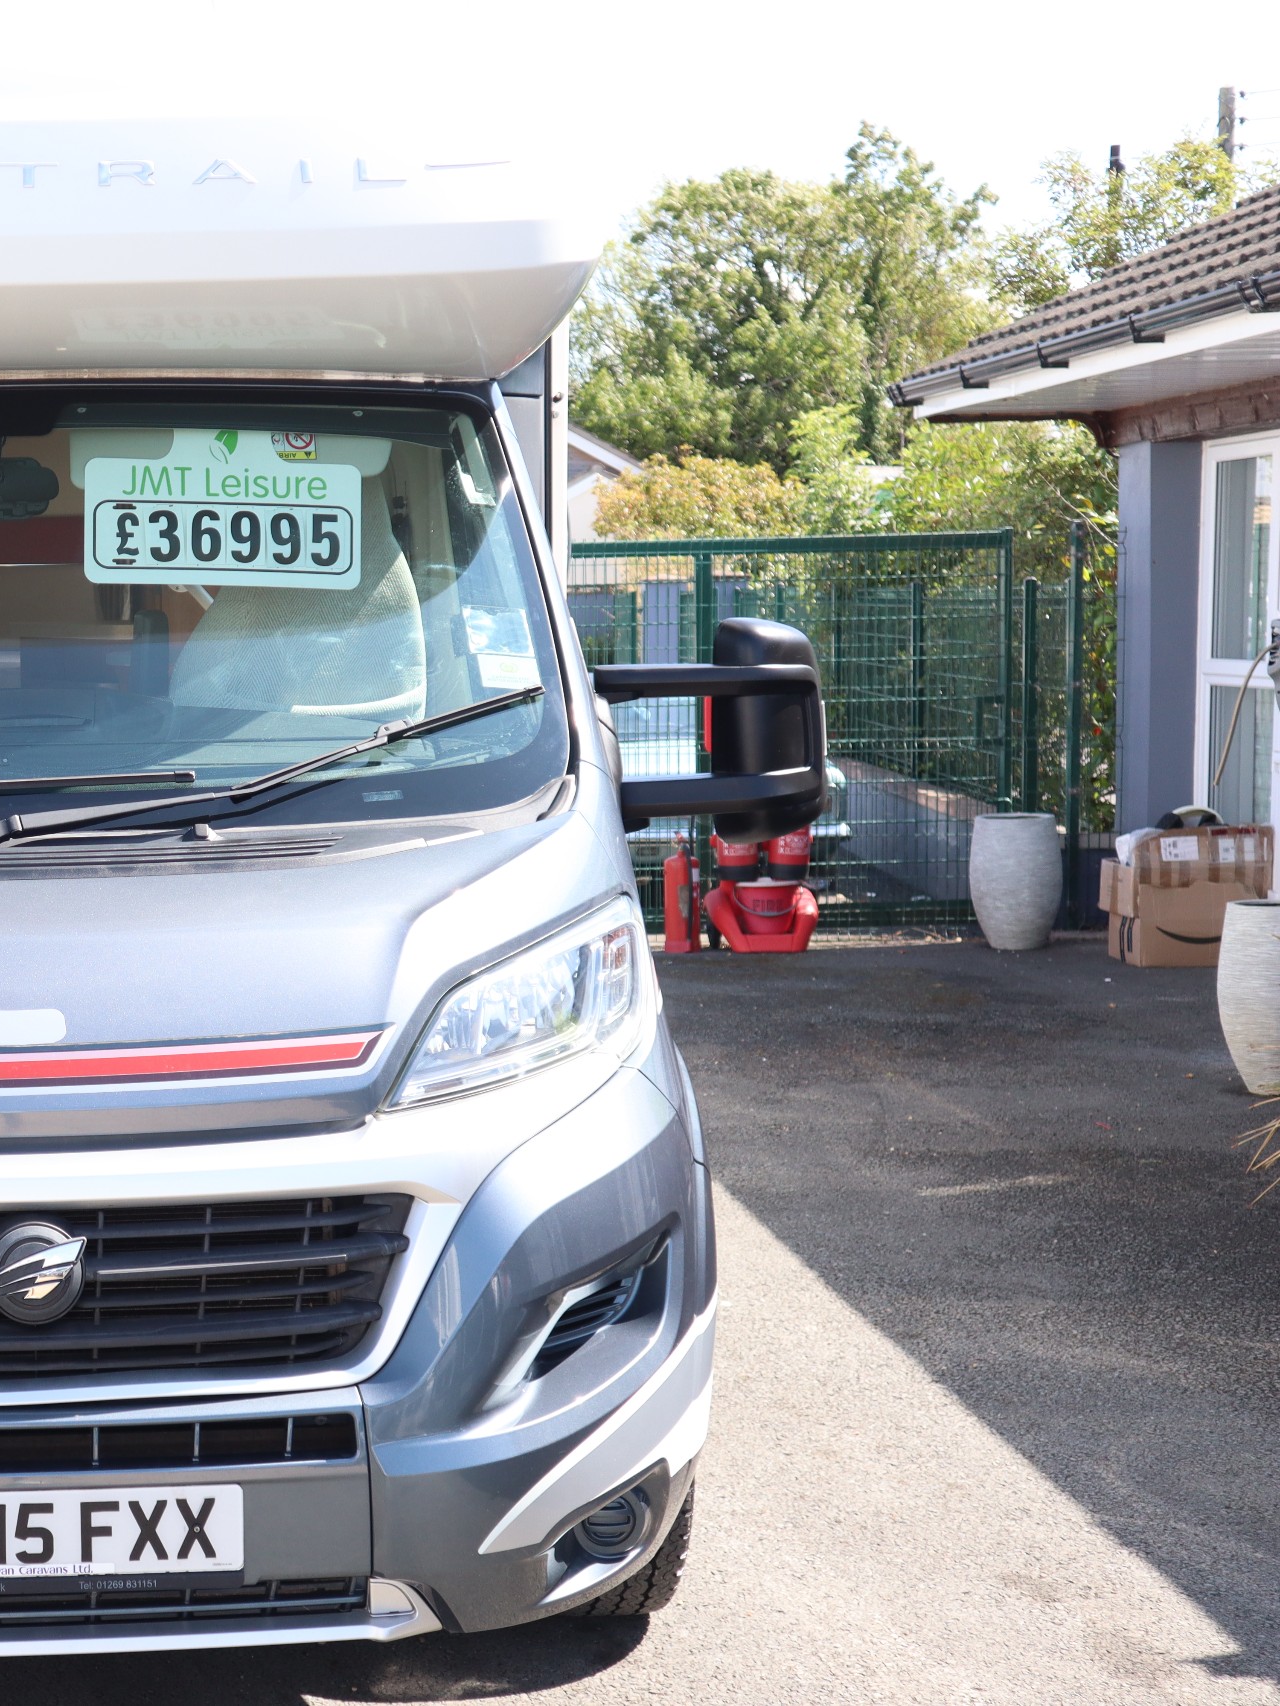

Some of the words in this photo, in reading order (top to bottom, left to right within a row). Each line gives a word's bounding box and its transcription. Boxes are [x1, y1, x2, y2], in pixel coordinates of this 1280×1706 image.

[122, 465, 192, 496] JMT
[206, 468, 328, 500] Leisure
[116, 509, 341, 567] £36995
[80, 1498, 217, 1562] FXX
[19, 1565, 68, 1575] Caravans
[72, 1564, 94, 1574] Ltd.
[79, 1580, 94, 1590] Tel:
[96, 1580, 124, 1590] 01269
[126, 1579, 158, 1589] 831151
